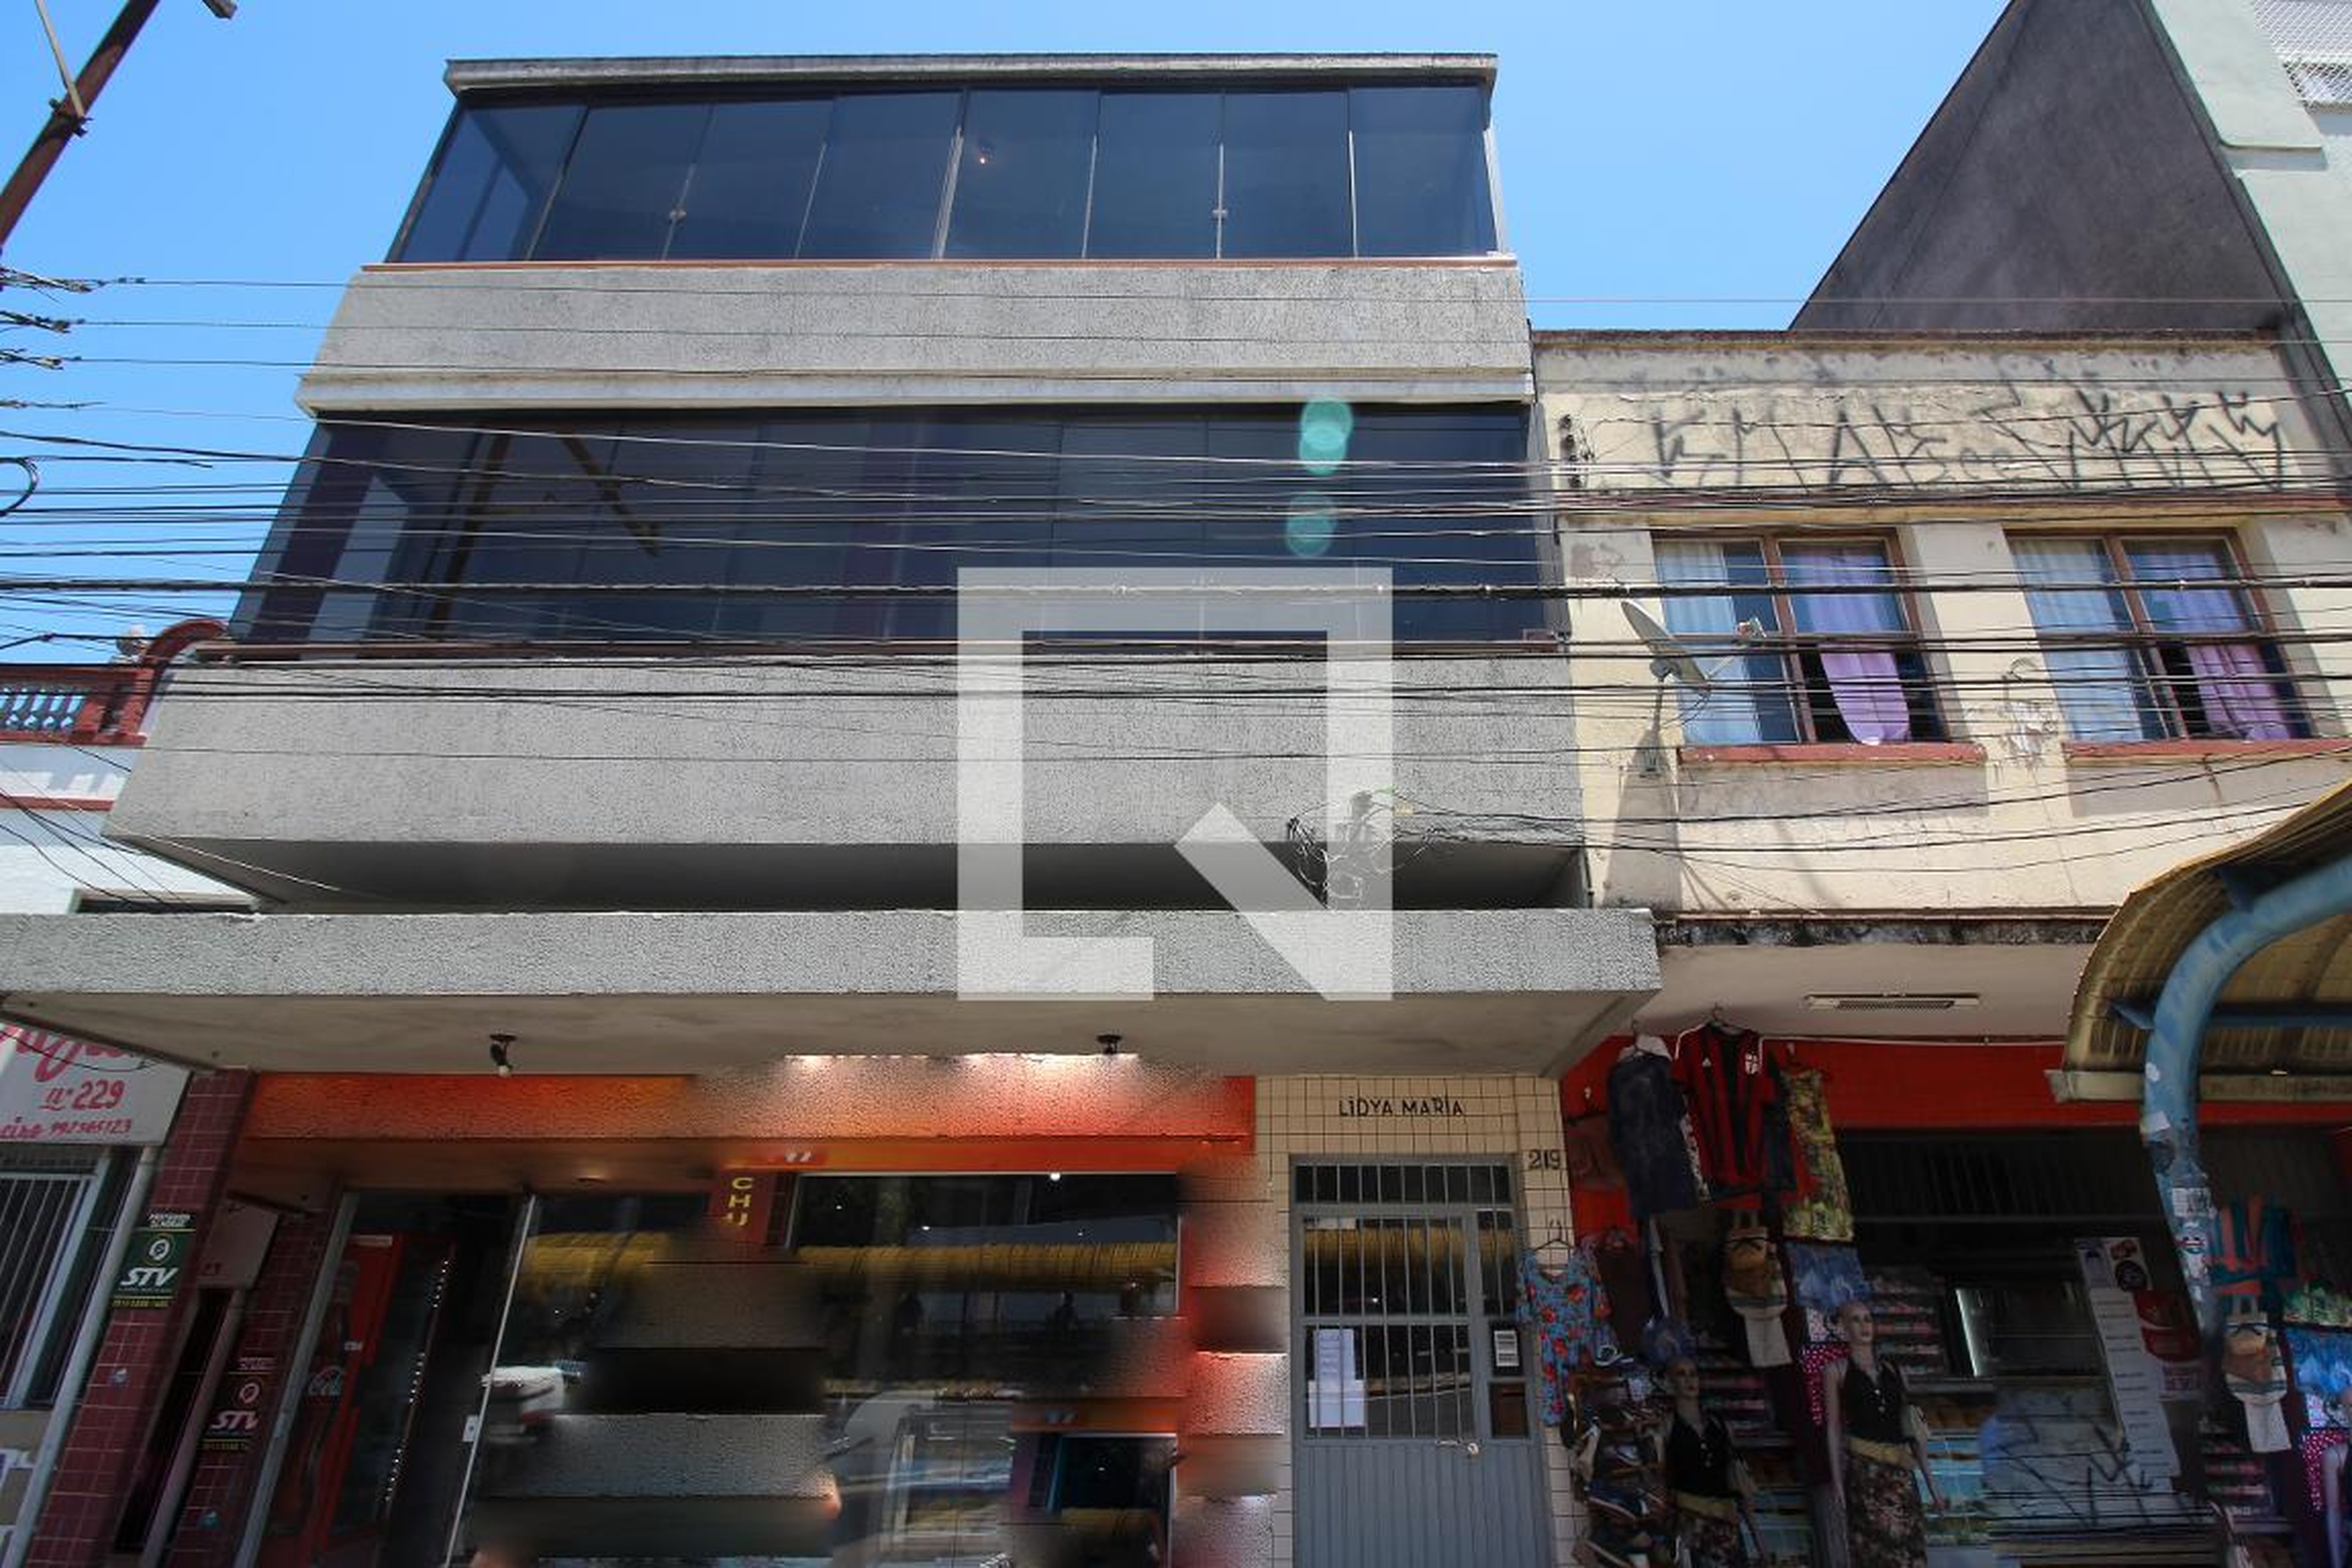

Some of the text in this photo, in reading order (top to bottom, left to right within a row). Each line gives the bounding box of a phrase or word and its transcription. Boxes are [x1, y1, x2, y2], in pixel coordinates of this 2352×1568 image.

[72, 1079, 126, 1110] 229
[1529, 1150, 1561, 1170] 219
[120, 1267, 179, 1287] STV
